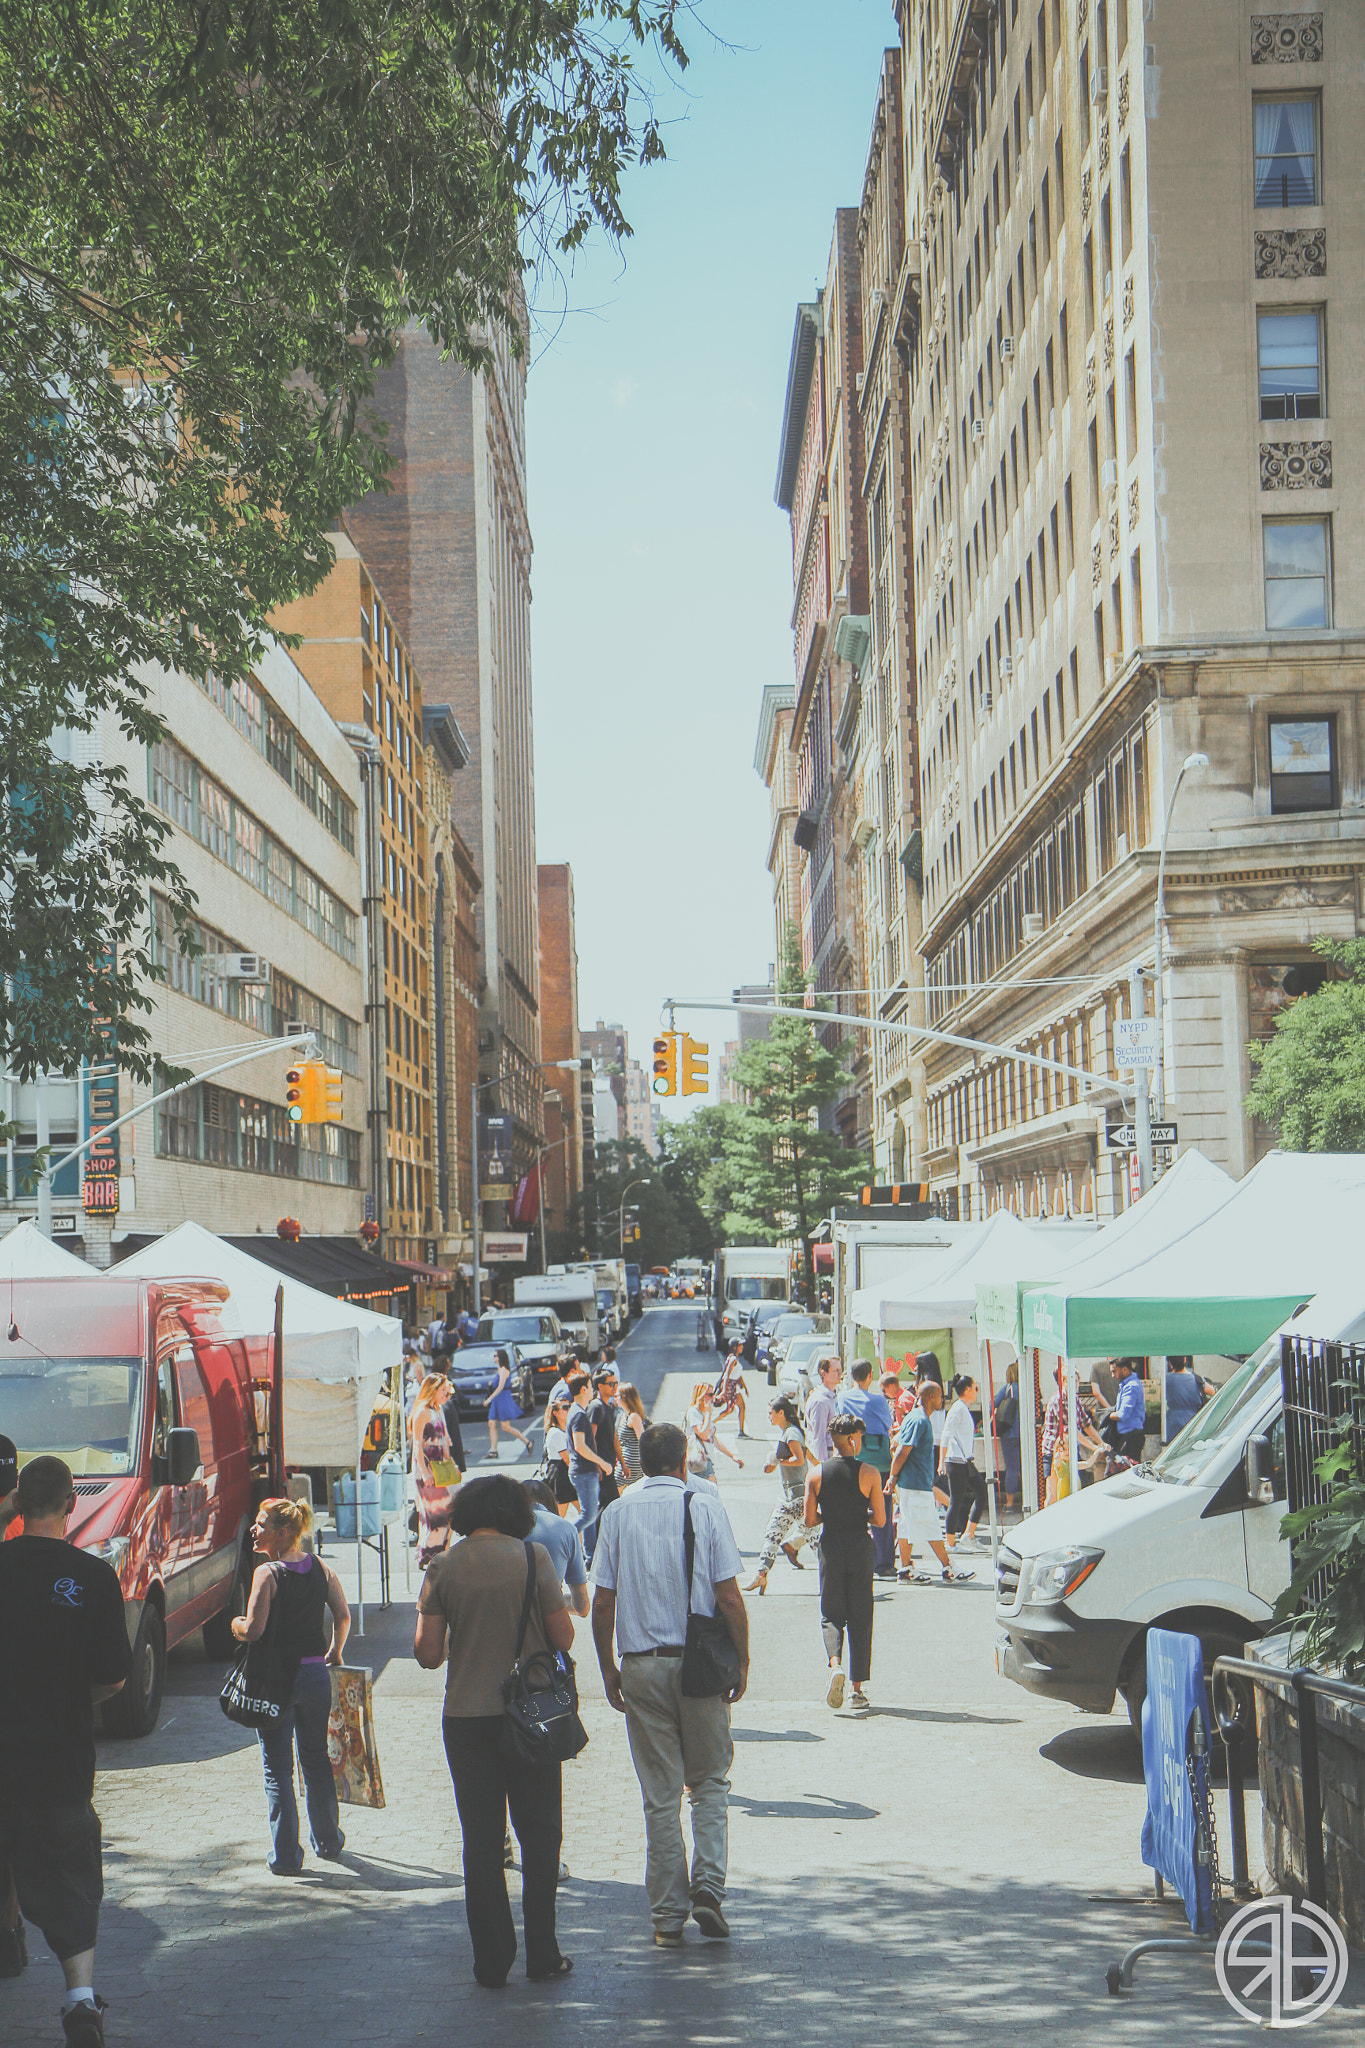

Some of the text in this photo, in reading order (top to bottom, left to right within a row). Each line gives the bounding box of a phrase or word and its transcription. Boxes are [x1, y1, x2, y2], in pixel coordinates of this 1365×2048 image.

[1120, 1022, 1149, 1034] NYPD
[1115, 1045, 1154, 1061] SECURITY
[1117, 1055, 1153, 1066] CAMERA
[1119, 1129, 1170, 1141] ON WAY
[84, 1158, 116, 1172] SHOP
[84, 1180, 115, 1207] BAR
[52, 1219, 70, 1228] WAY
